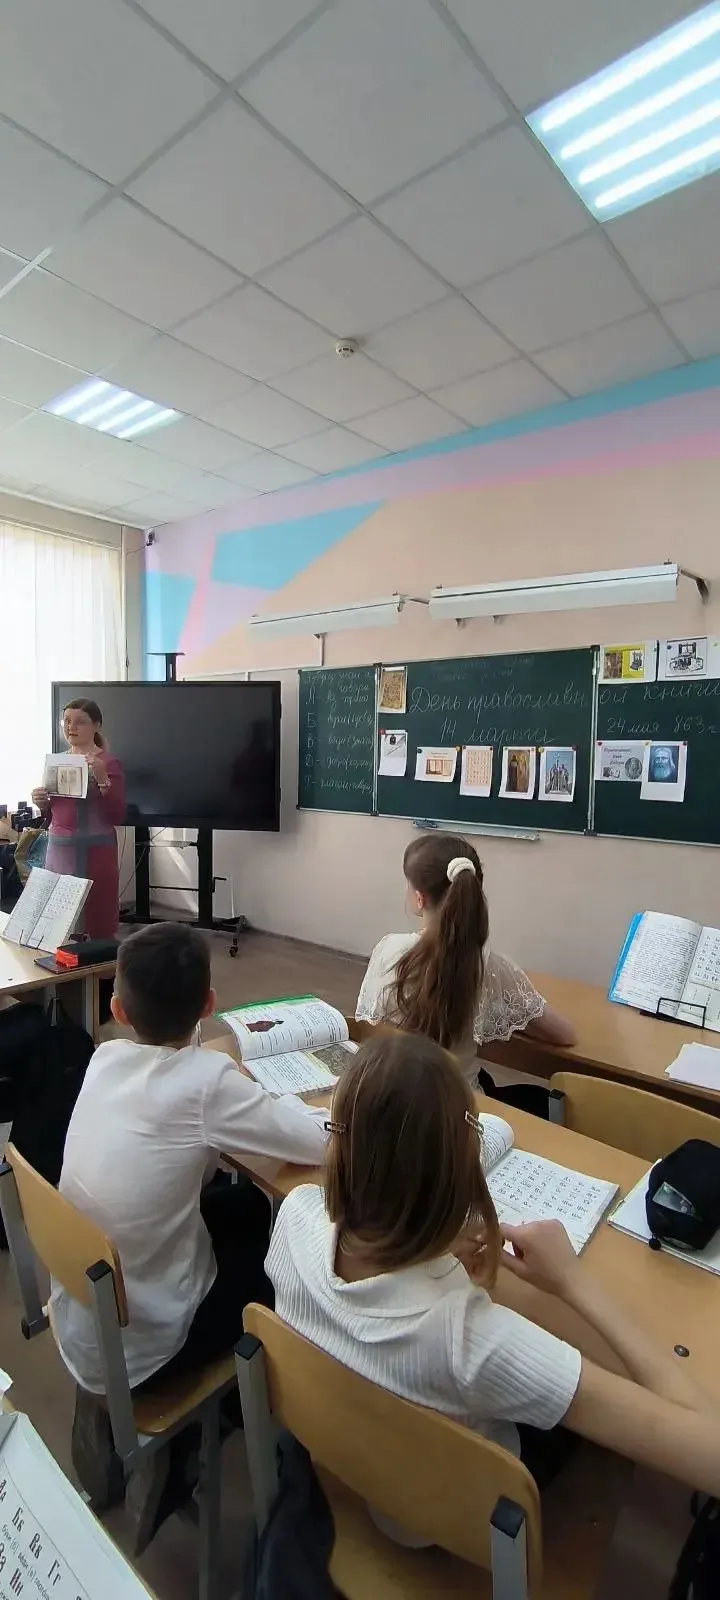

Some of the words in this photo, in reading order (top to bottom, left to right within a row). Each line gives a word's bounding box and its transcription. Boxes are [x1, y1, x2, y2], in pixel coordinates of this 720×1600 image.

[409, 686, 461, 713] День
[440, 717, 457, 743] 14
[607, 717, 626, 734] 24
[627, 723, 660, 735] мая
[29, 1532, 43, 1559] Вв
[47, 1559, 61, 1586] Гг
